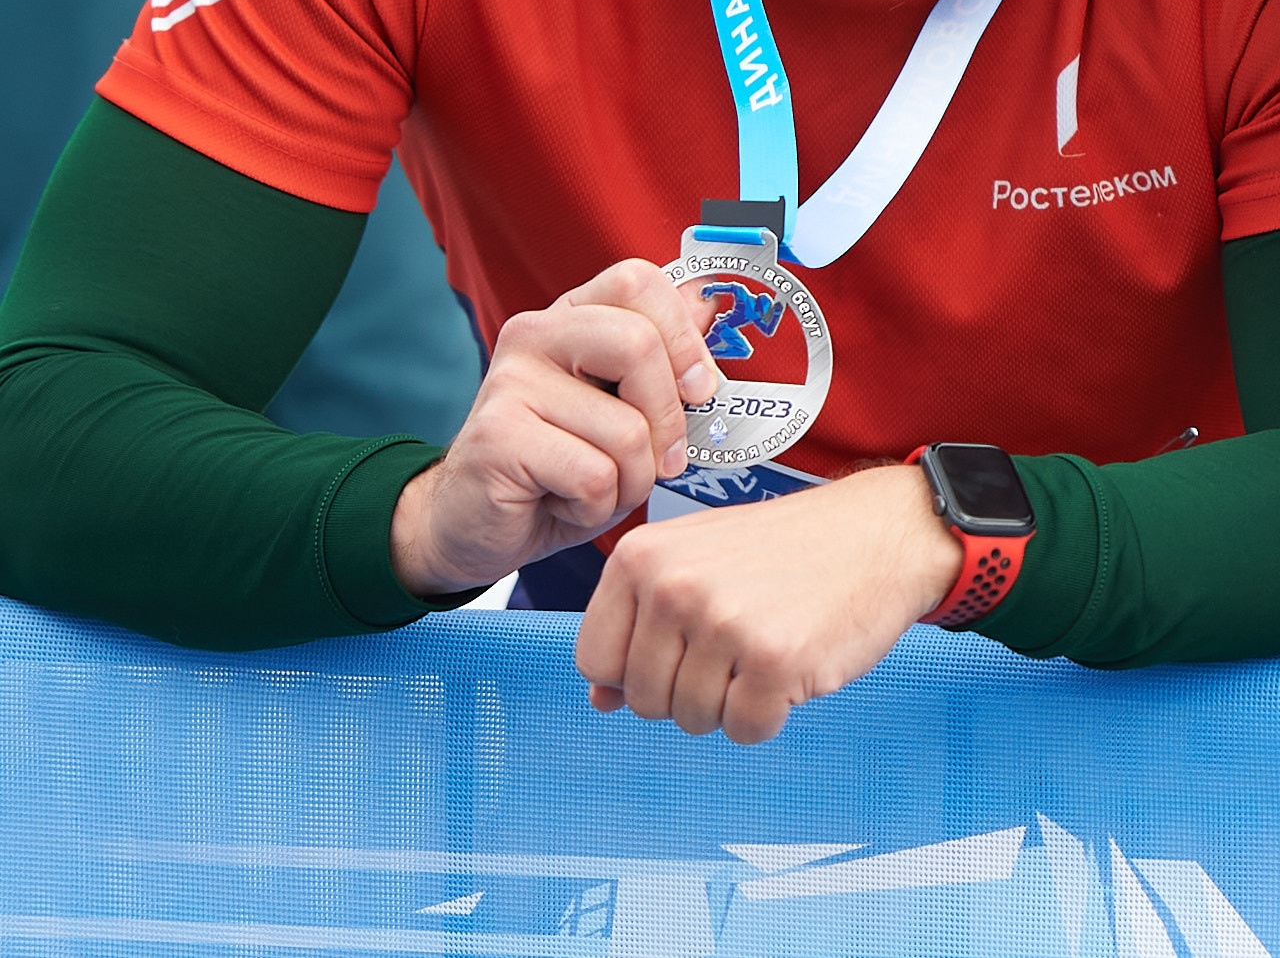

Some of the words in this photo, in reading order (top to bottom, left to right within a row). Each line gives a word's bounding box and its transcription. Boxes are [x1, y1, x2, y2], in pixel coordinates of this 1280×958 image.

[991, 165, 1178, 210] Ростелеком
[686, 255, 750, 273] бежит
[762, 267, 794, 293] все
[791, 289, 823, 338] бегут
[683, 395, 793, 419] 3-2023
[686, 444, 760, 464] овская
[762, 408, 809, 453] миля
